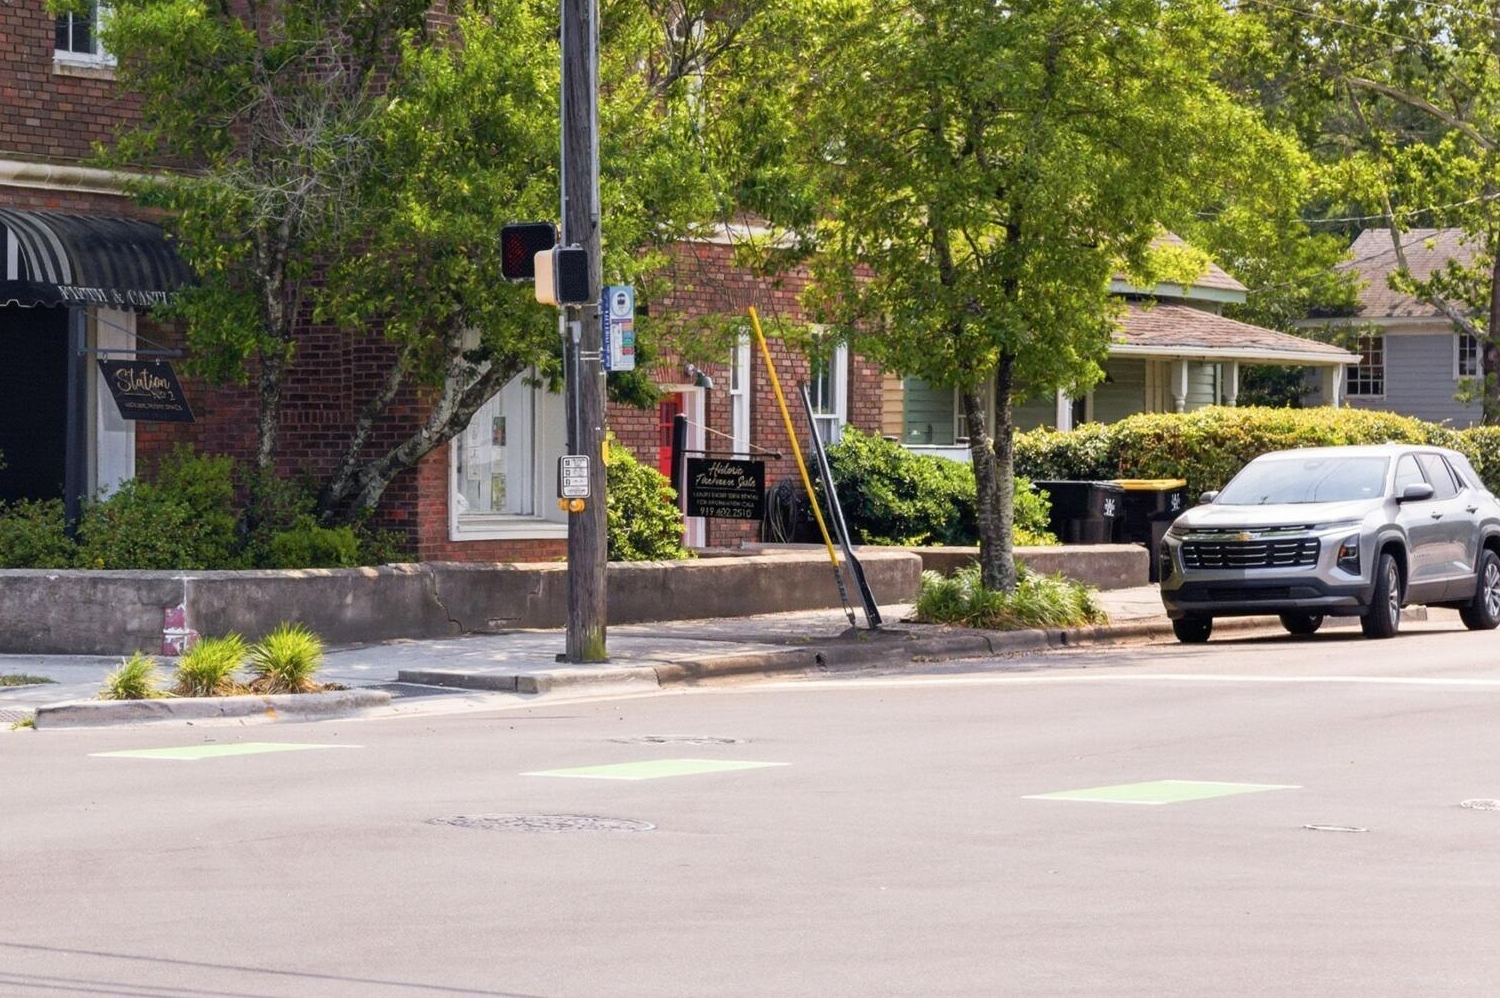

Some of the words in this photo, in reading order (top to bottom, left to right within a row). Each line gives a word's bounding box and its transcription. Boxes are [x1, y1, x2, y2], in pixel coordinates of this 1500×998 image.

[58, 285, 108, 303] FIFTH
[111, 288, 125, 304] &
[116, 368, 170, 392] Station
